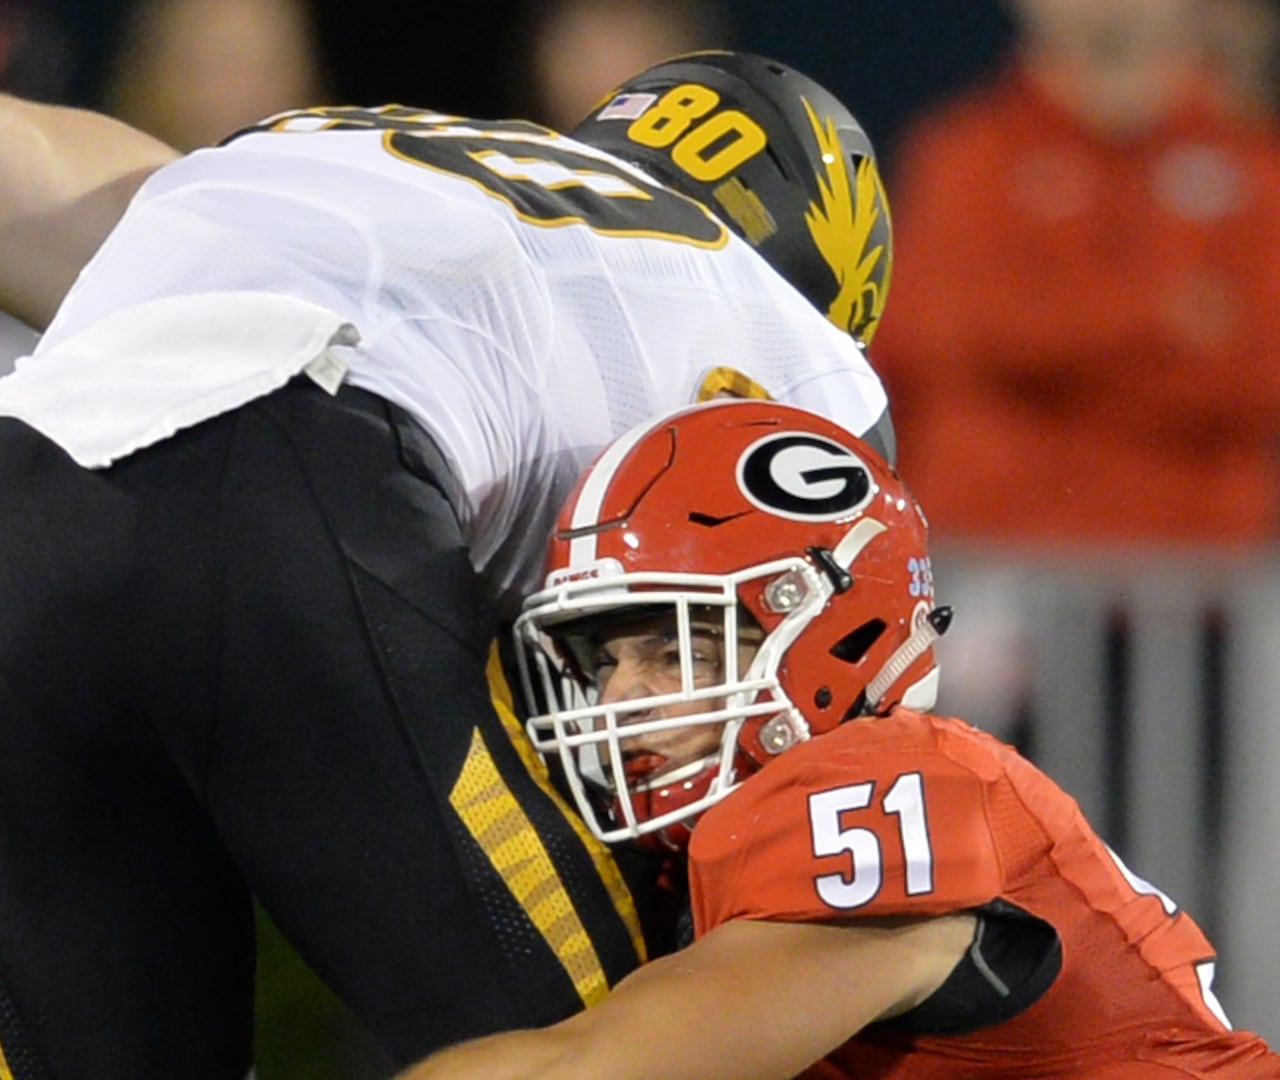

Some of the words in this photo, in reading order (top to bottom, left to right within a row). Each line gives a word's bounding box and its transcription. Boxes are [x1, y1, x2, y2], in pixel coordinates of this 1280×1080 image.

[627, 83, 767, 181] 80
[739, 433, 873, 520] G
[808, 770, 933, 910] 51
